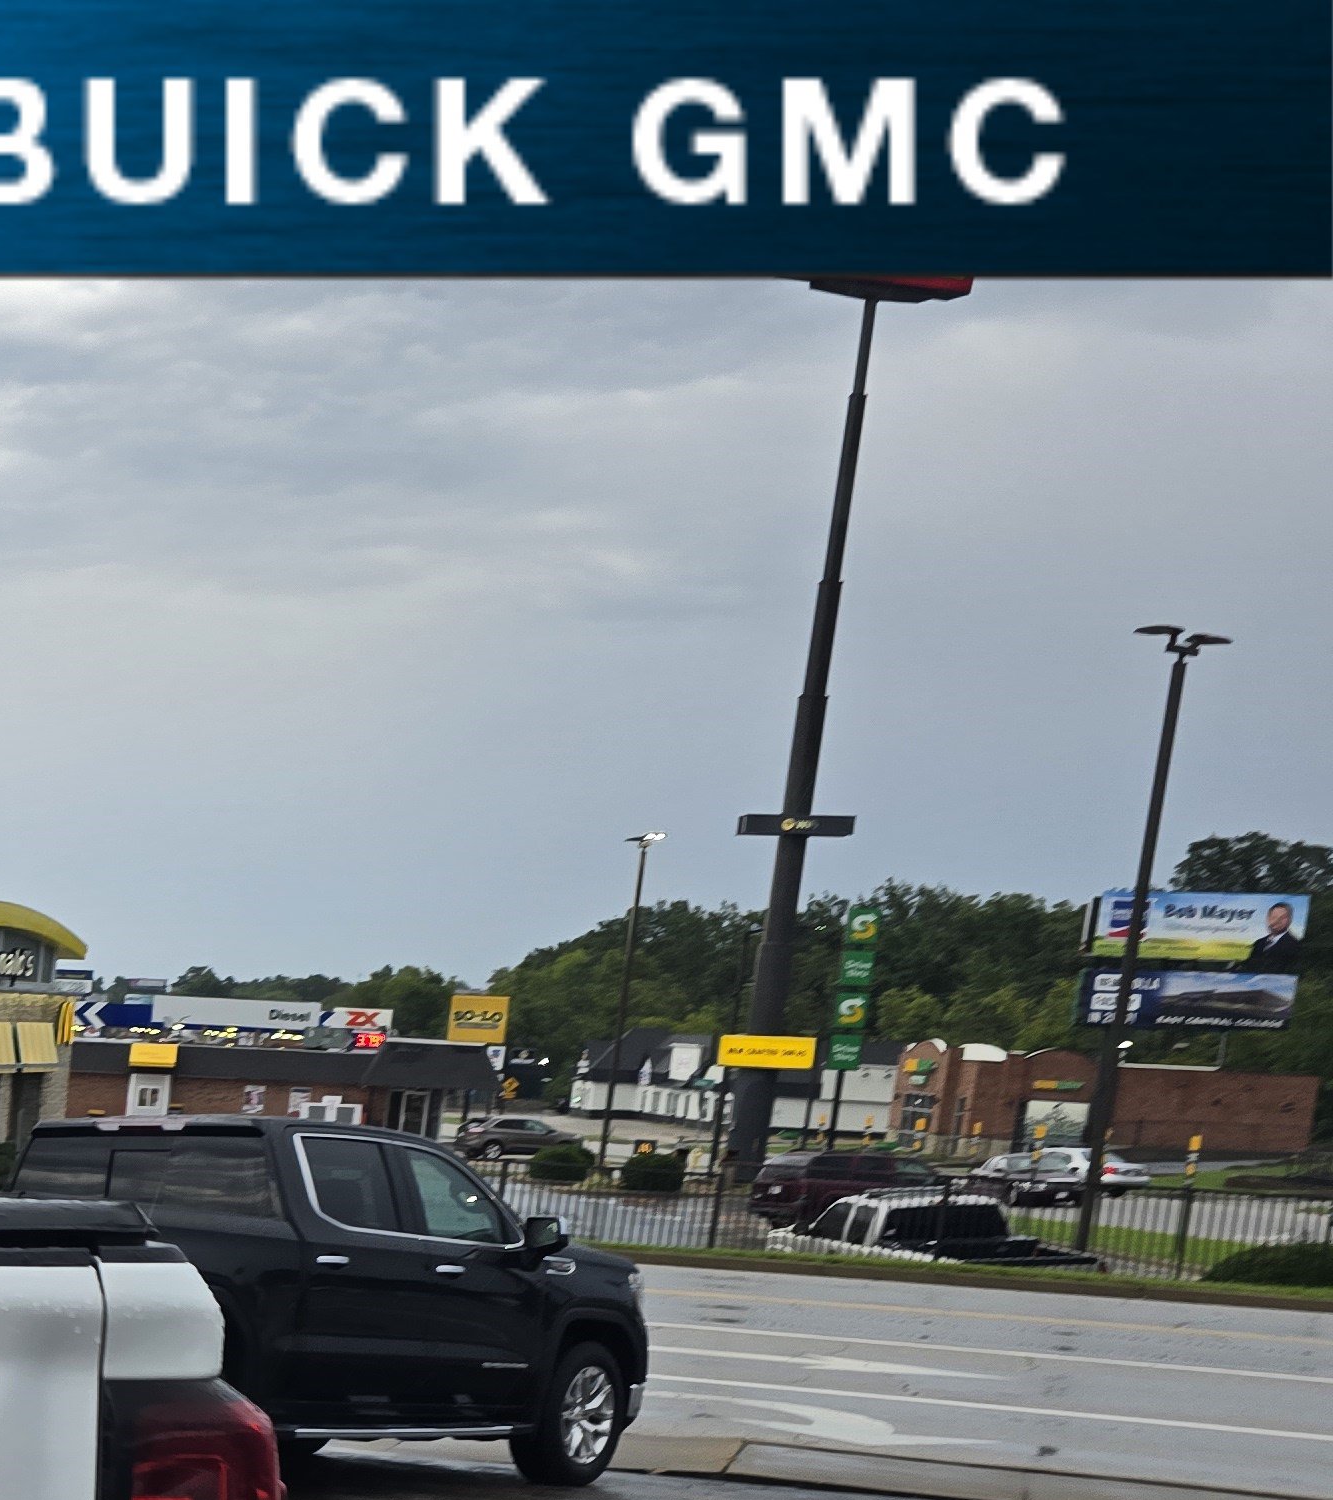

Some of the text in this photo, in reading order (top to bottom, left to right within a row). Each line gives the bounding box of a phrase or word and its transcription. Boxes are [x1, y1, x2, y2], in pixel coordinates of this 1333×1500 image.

[1163, 903, 1257, 923] Bob Mayer
[268, 1008, 311, 1022] Diesel
[346, 1011, 380, 1027] ZX
